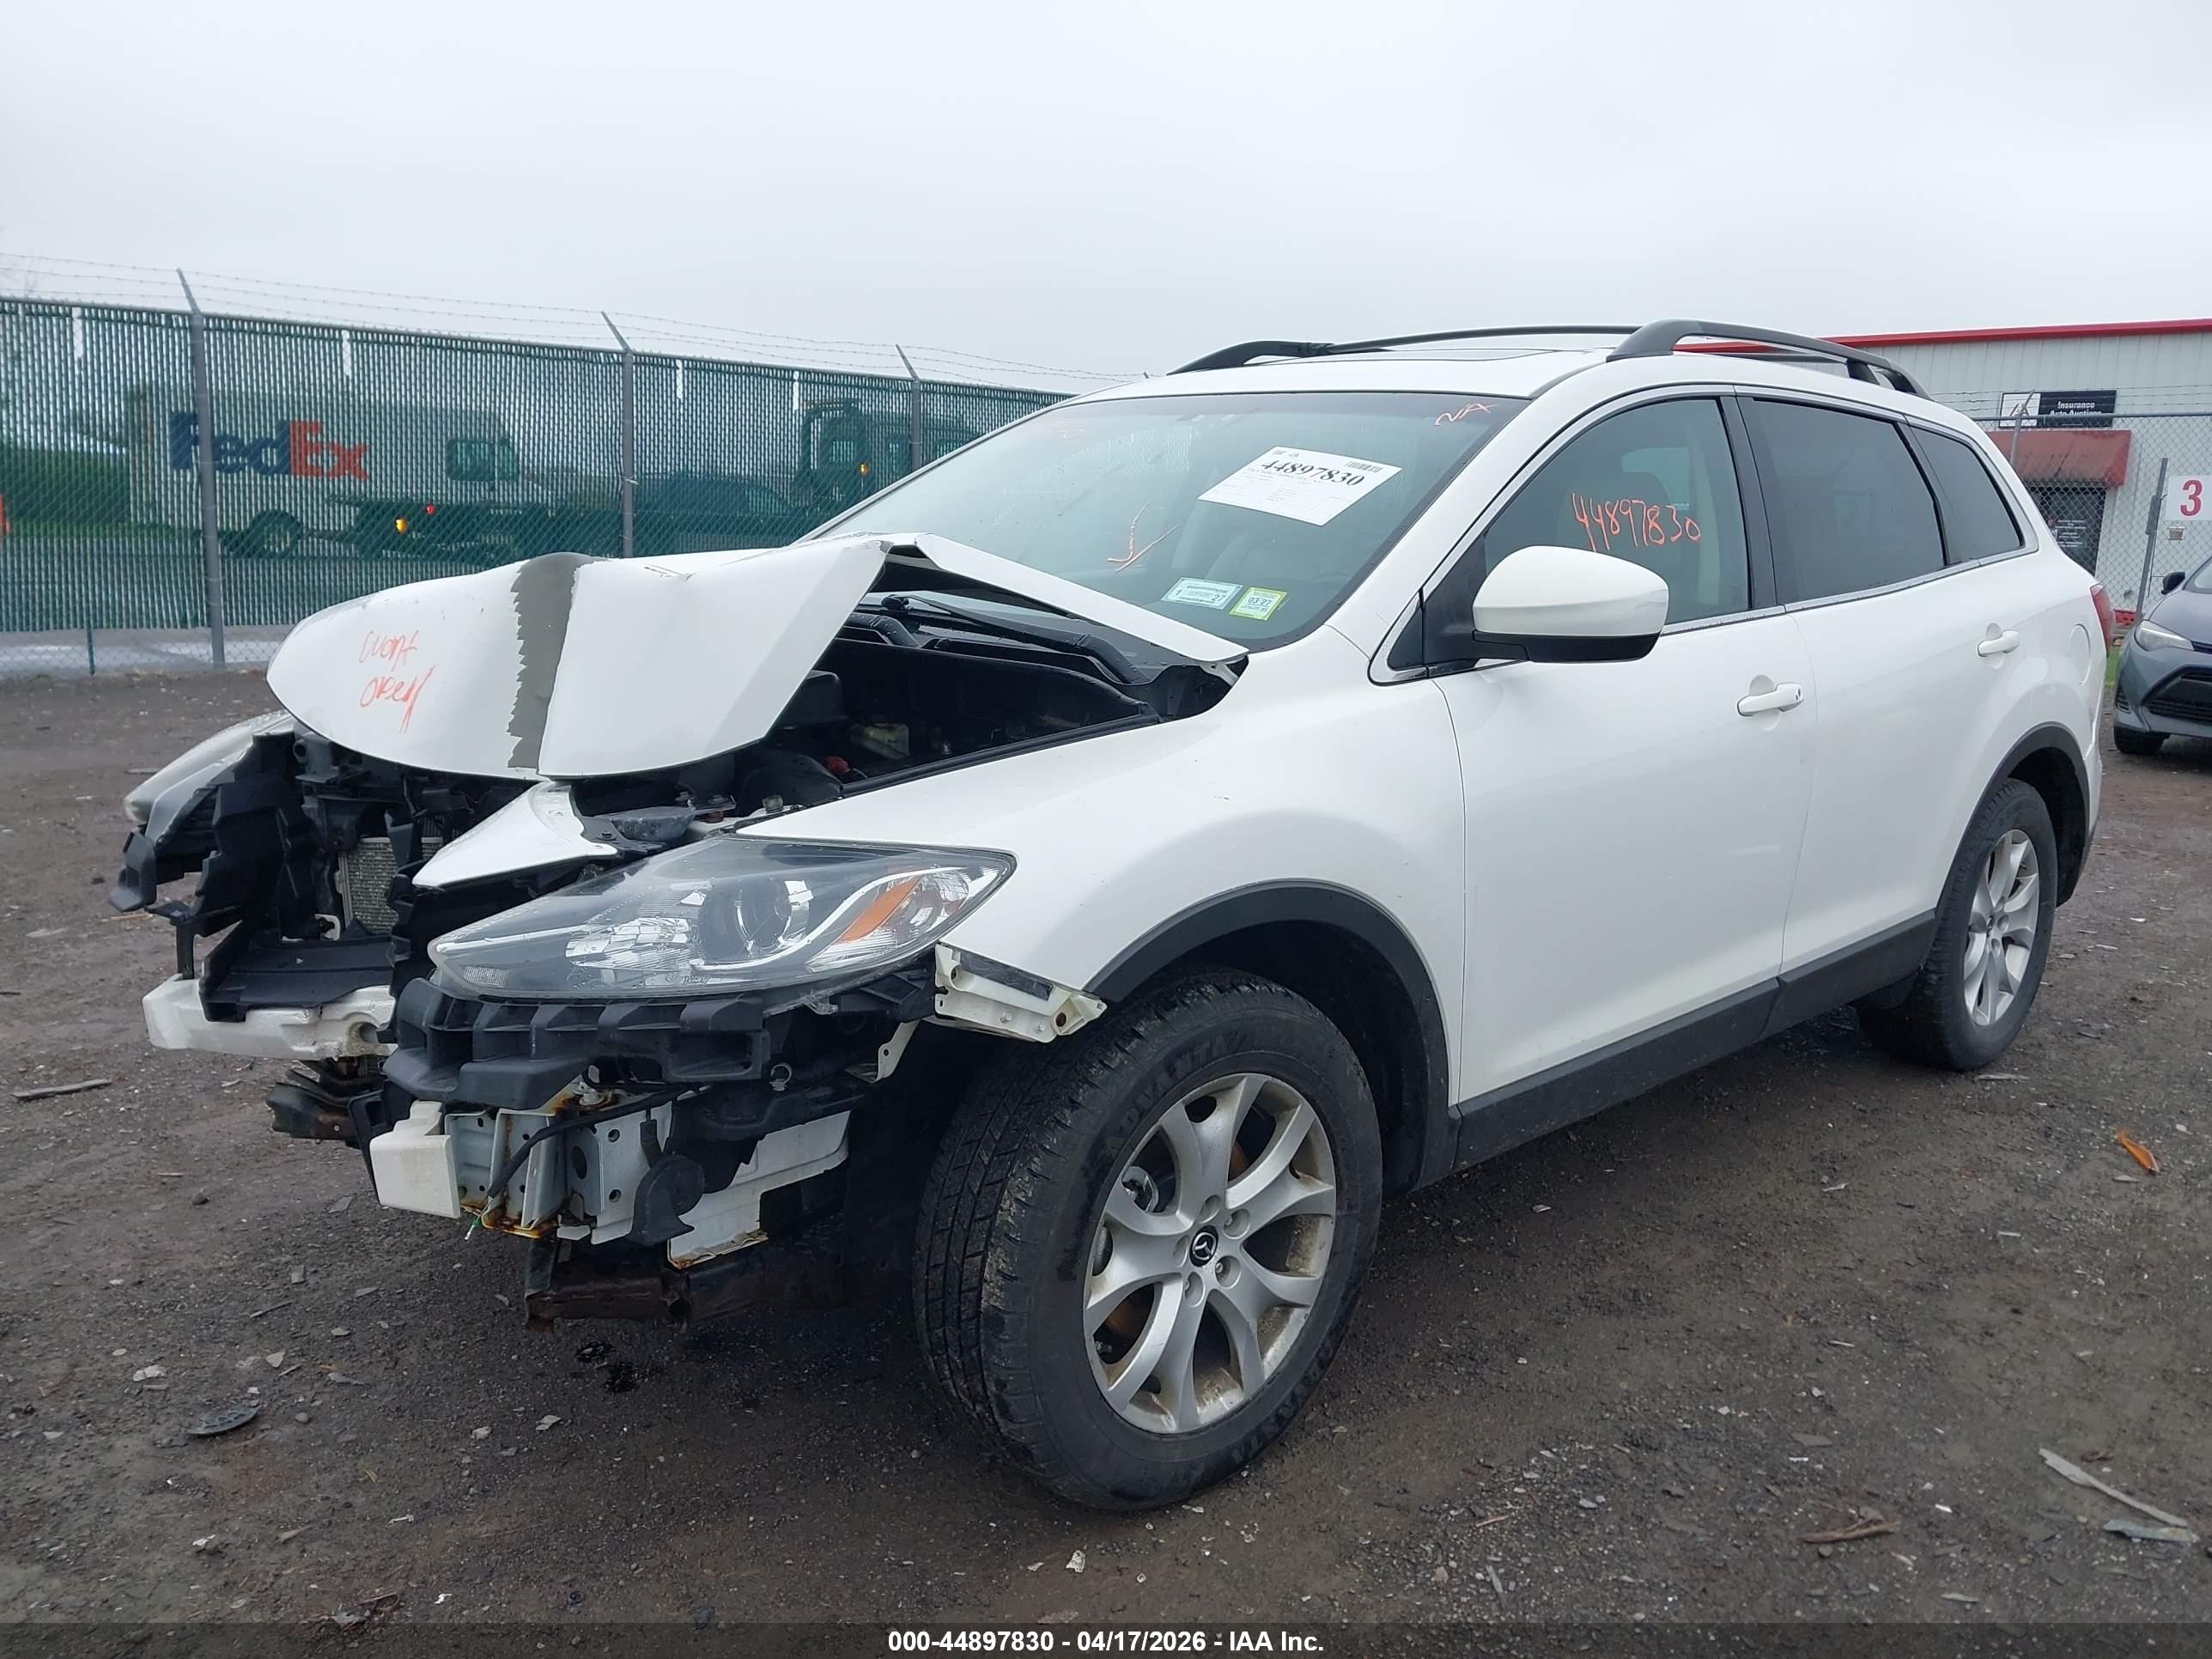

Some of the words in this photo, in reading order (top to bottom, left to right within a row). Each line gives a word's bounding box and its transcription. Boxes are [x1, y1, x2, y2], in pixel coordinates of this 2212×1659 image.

[2057, 400, 2095, 410] Insurance
[171, 410, 370, 481] FedEx
[1261, 459, 1366, 486] 44897830
[2180, 479, 2203, 517] 3
[1571, 492, 1702, 553] 44897830
